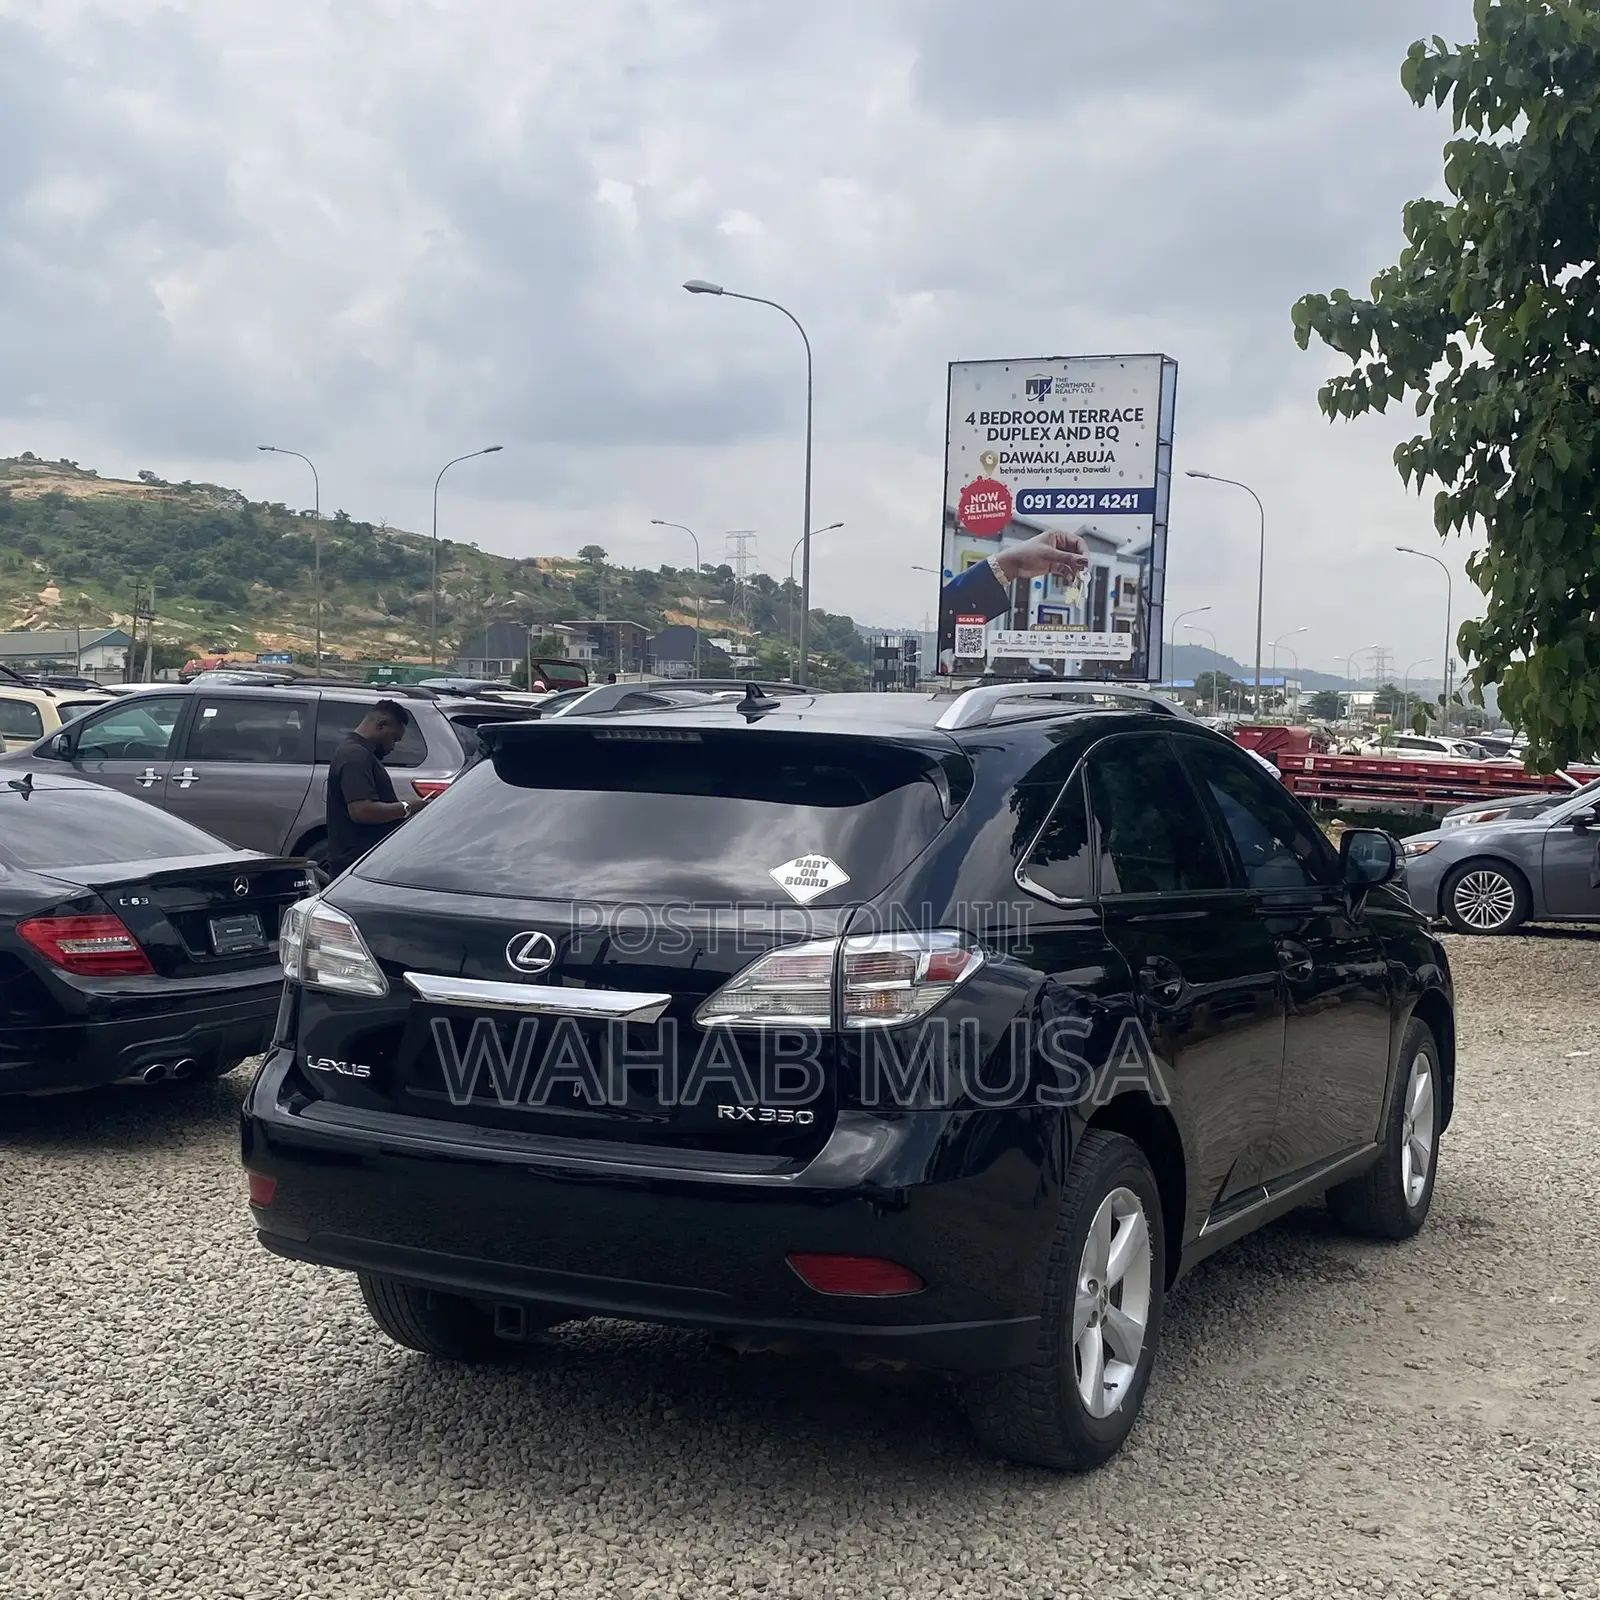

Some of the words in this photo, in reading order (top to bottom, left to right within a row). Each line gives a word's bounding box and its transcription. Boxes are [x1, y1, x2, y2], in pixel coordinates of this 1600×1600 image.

[965, 412, 976, 425] 4
[980, 410, 1065, 425] BEDROOM
[1069, 408, 1144, 423] TERRACE
[987, 427, 1051, 441] DUPLEX
[1054, 426, 1091, 440] AND
[1095, 426, 1120, 442] BQ
[1000, 451, 1059, 464] DAWAKI
[1083, 466, 1111, 474] Dawaki
[970, 491, 999, 504] NOW
[1023, 494, 1052, 509] 091
[1055, 494, 1095, 509] 2021
[1099, 494, 1139, 509] 4241
[964, 501, 1007, 514] SELLING
[794, 859, 829, 869] BABY
[800, 868, 819, 877] ON
[784, 876, 829, 888] BOARD
[131, 897, 149, 905] 63
[307, 1055, 371, 1077] LEXUS
[717, 1104, 756, 1121] RX
[758, 1107, 814, 1124] 350
